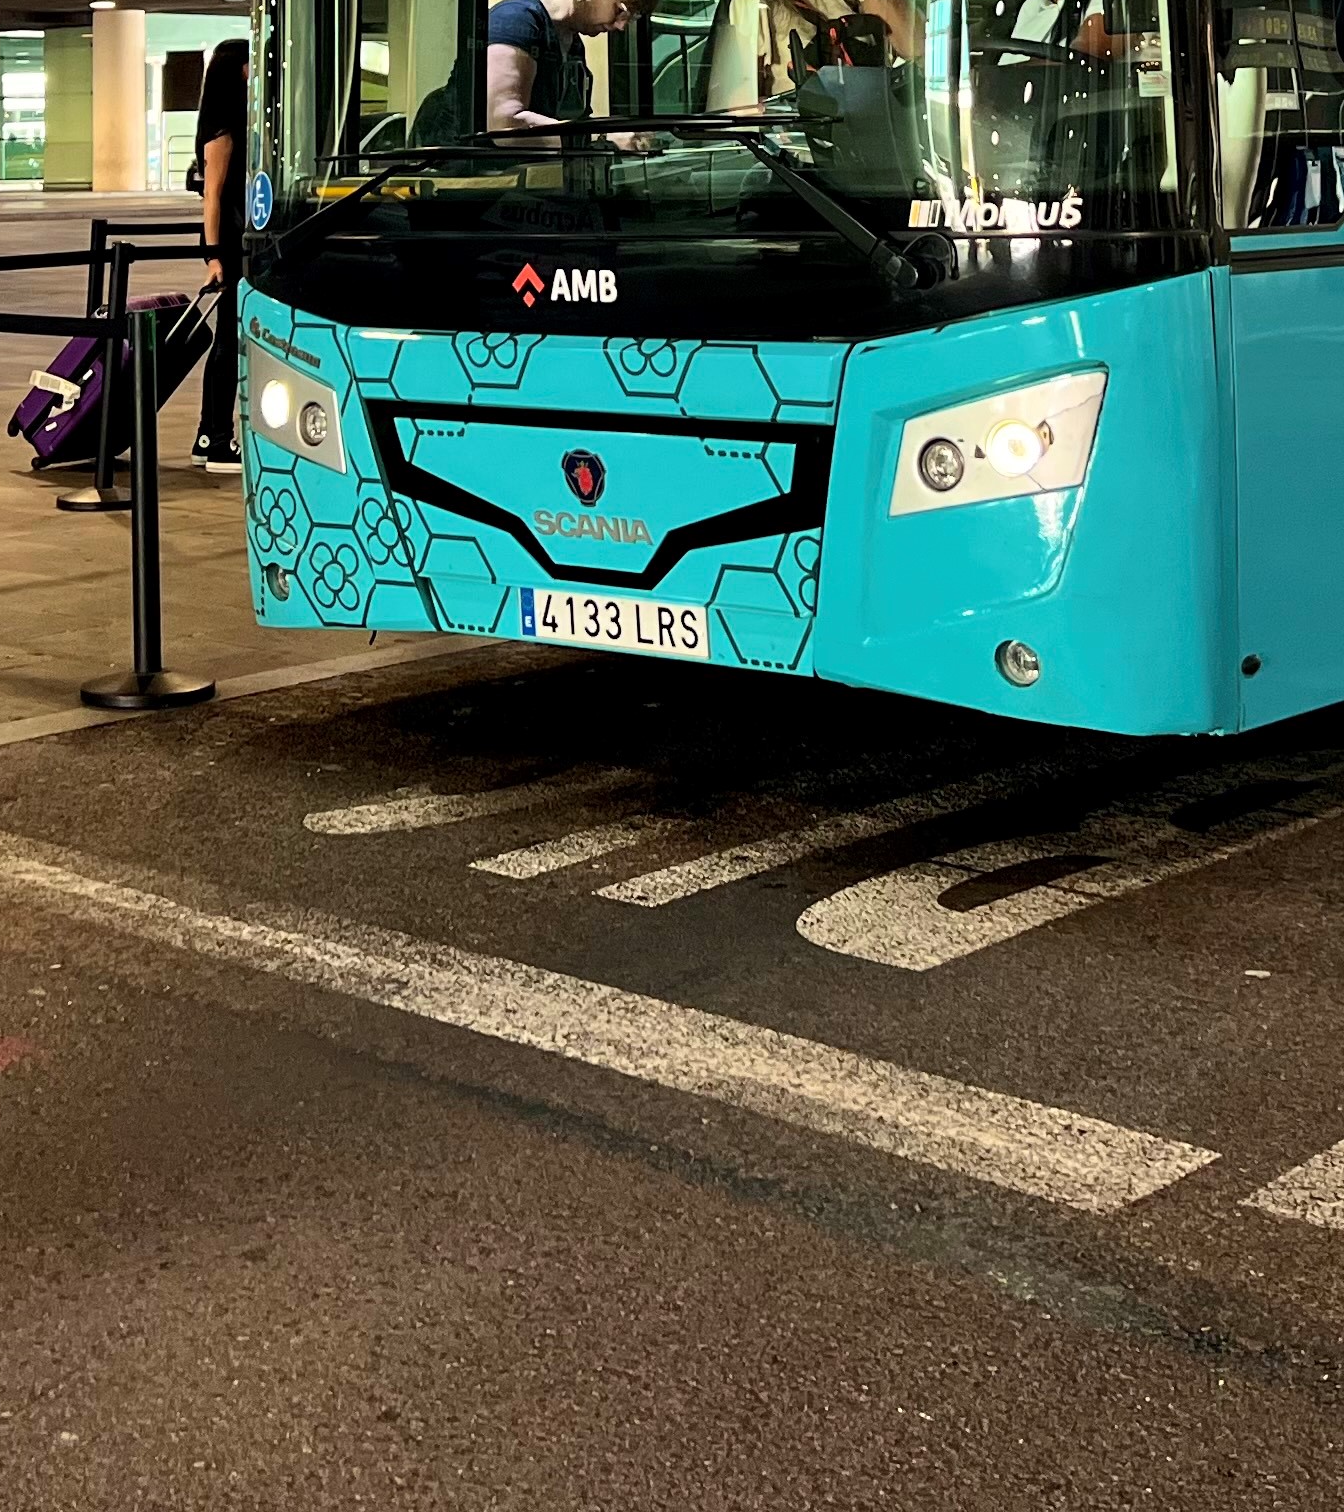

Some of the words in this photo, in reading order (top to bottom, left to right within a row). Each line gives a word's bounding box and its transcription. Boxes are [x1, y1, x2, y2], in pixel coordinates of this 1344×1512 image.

[550, 268, 618, 304] AMB
[533, 509, 654, 546] SCANIA
[524, 615, 533, 628] E
[541, 594, 622, 640] 4133
[635, 603, 699, 649] LRS
